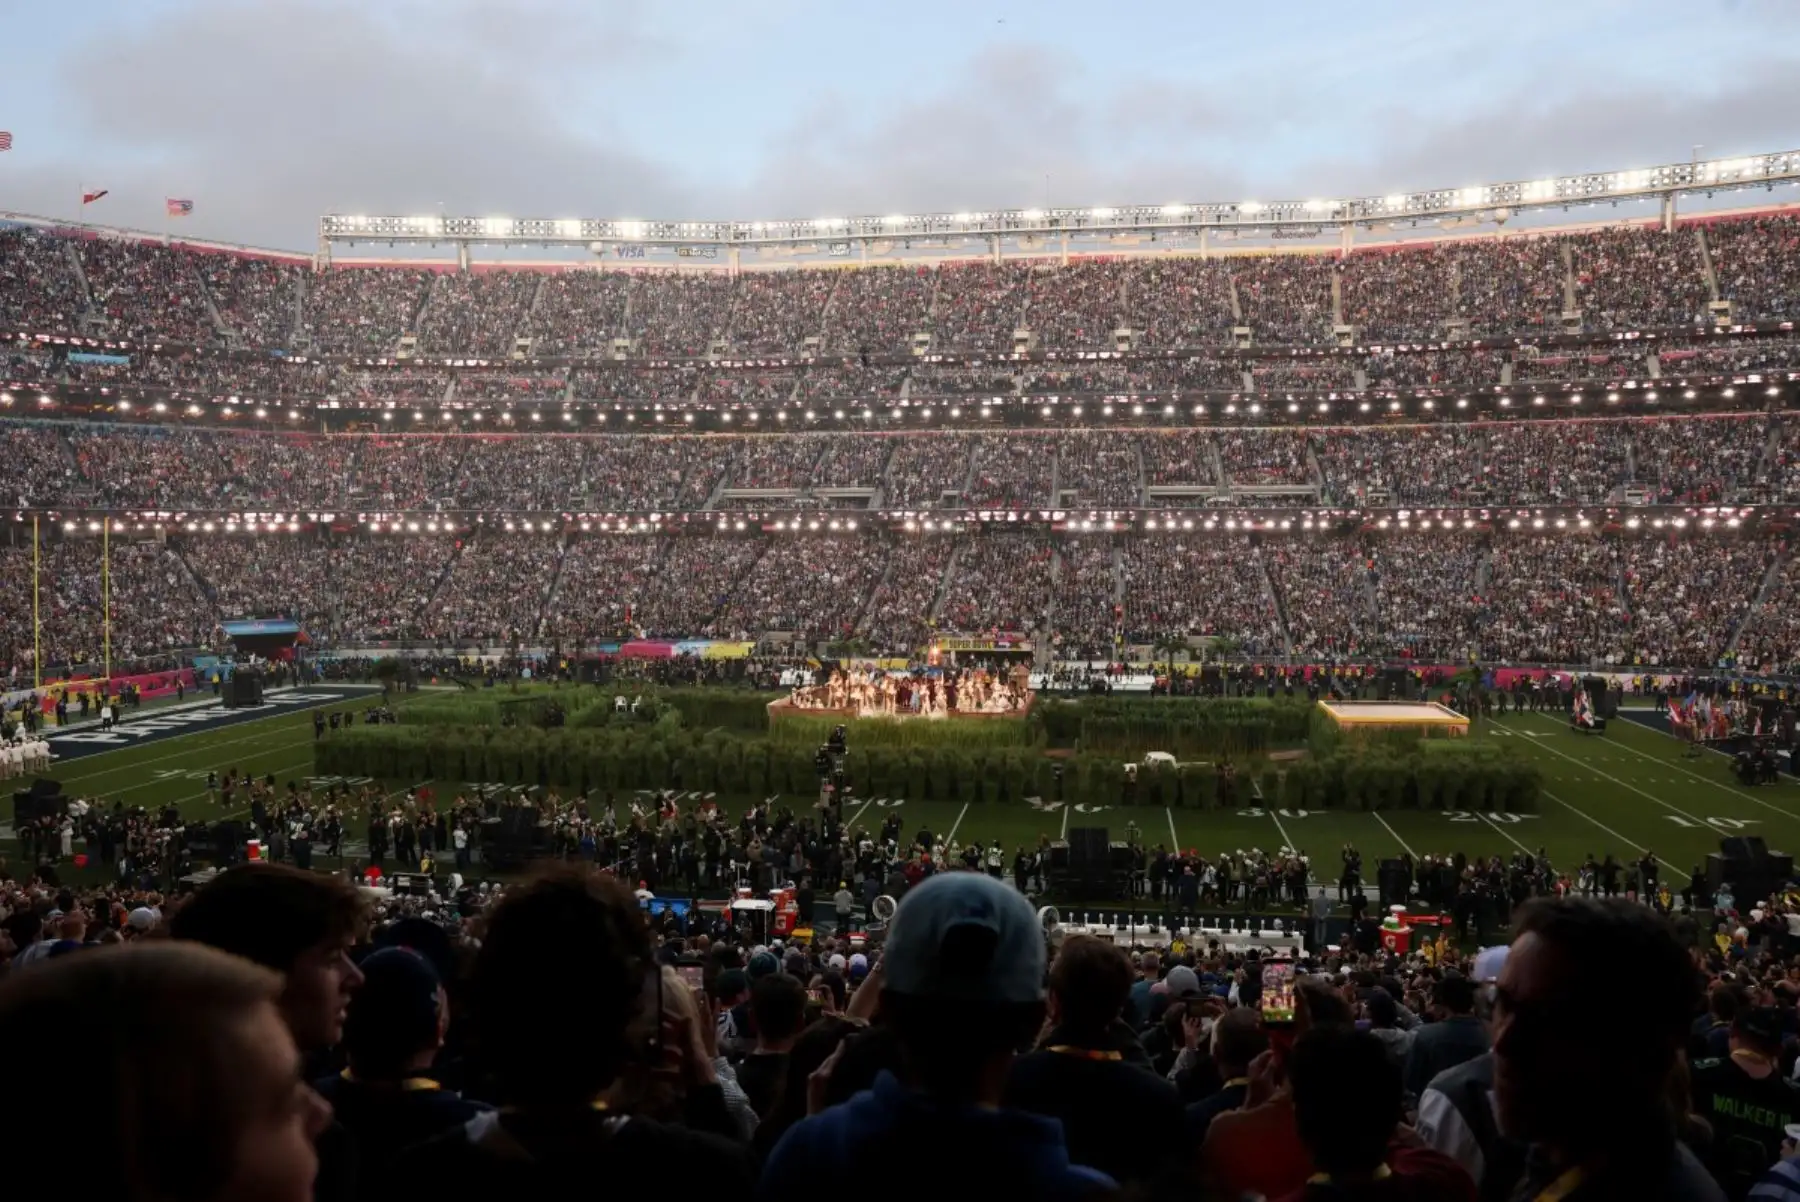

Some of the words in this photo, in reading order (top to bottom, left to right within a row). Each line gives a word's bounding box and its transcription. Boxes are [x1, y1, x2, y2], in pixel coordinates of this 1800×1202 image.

[617, 246, 645, 258] VISA
[948, 639, 971, 649] SUPER
[1441, 811, 1522, 823] 20
[1662, 815, 1744, 828] 10
[1712, 1092, 1777, 1130] WALKER
